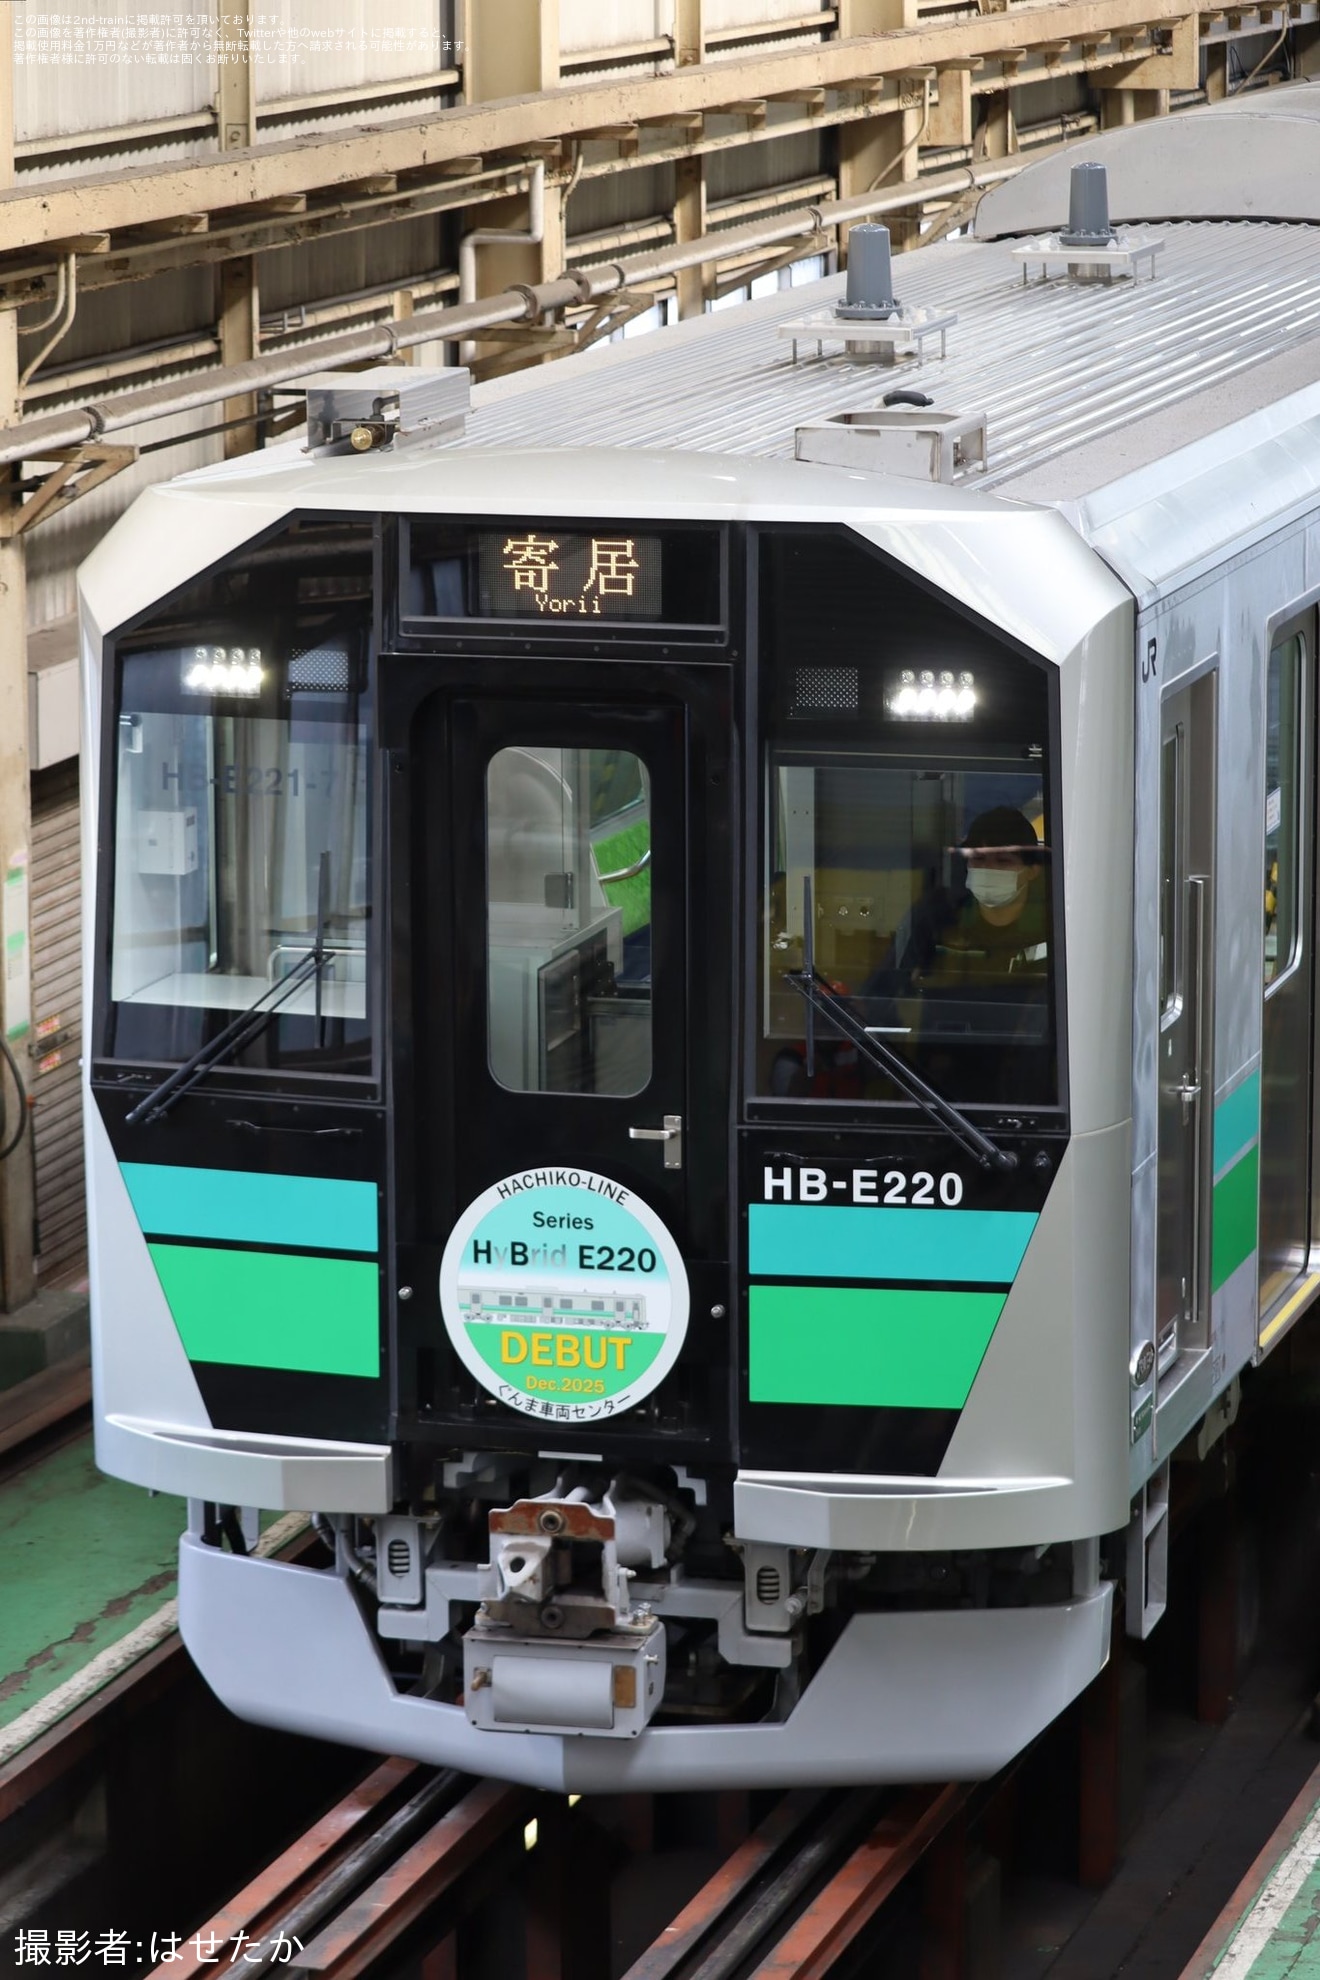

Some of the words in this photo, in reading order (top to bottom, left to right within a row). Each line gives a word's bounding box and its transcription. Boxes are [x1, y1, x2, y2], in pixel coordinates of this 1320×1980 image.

[535, 594, 601, 613] Yorii
[1142, 637, 1157, 684] JR
[496, 1170, 630, 1206] HACHIKO-LINE
[763, 1166, 964, 1206] HB-E220
[532, 1210, 594, 1230] Series
[472, 1239, 567, 1269] HyBrid
[578, 1244, 657, 1273] E220
[501, 1330, 633, 1371] DEBUT
[498, 1383, 631, 1421] ぐんま車両センター
[525, 1375, 606, 1394] Dec.2025
